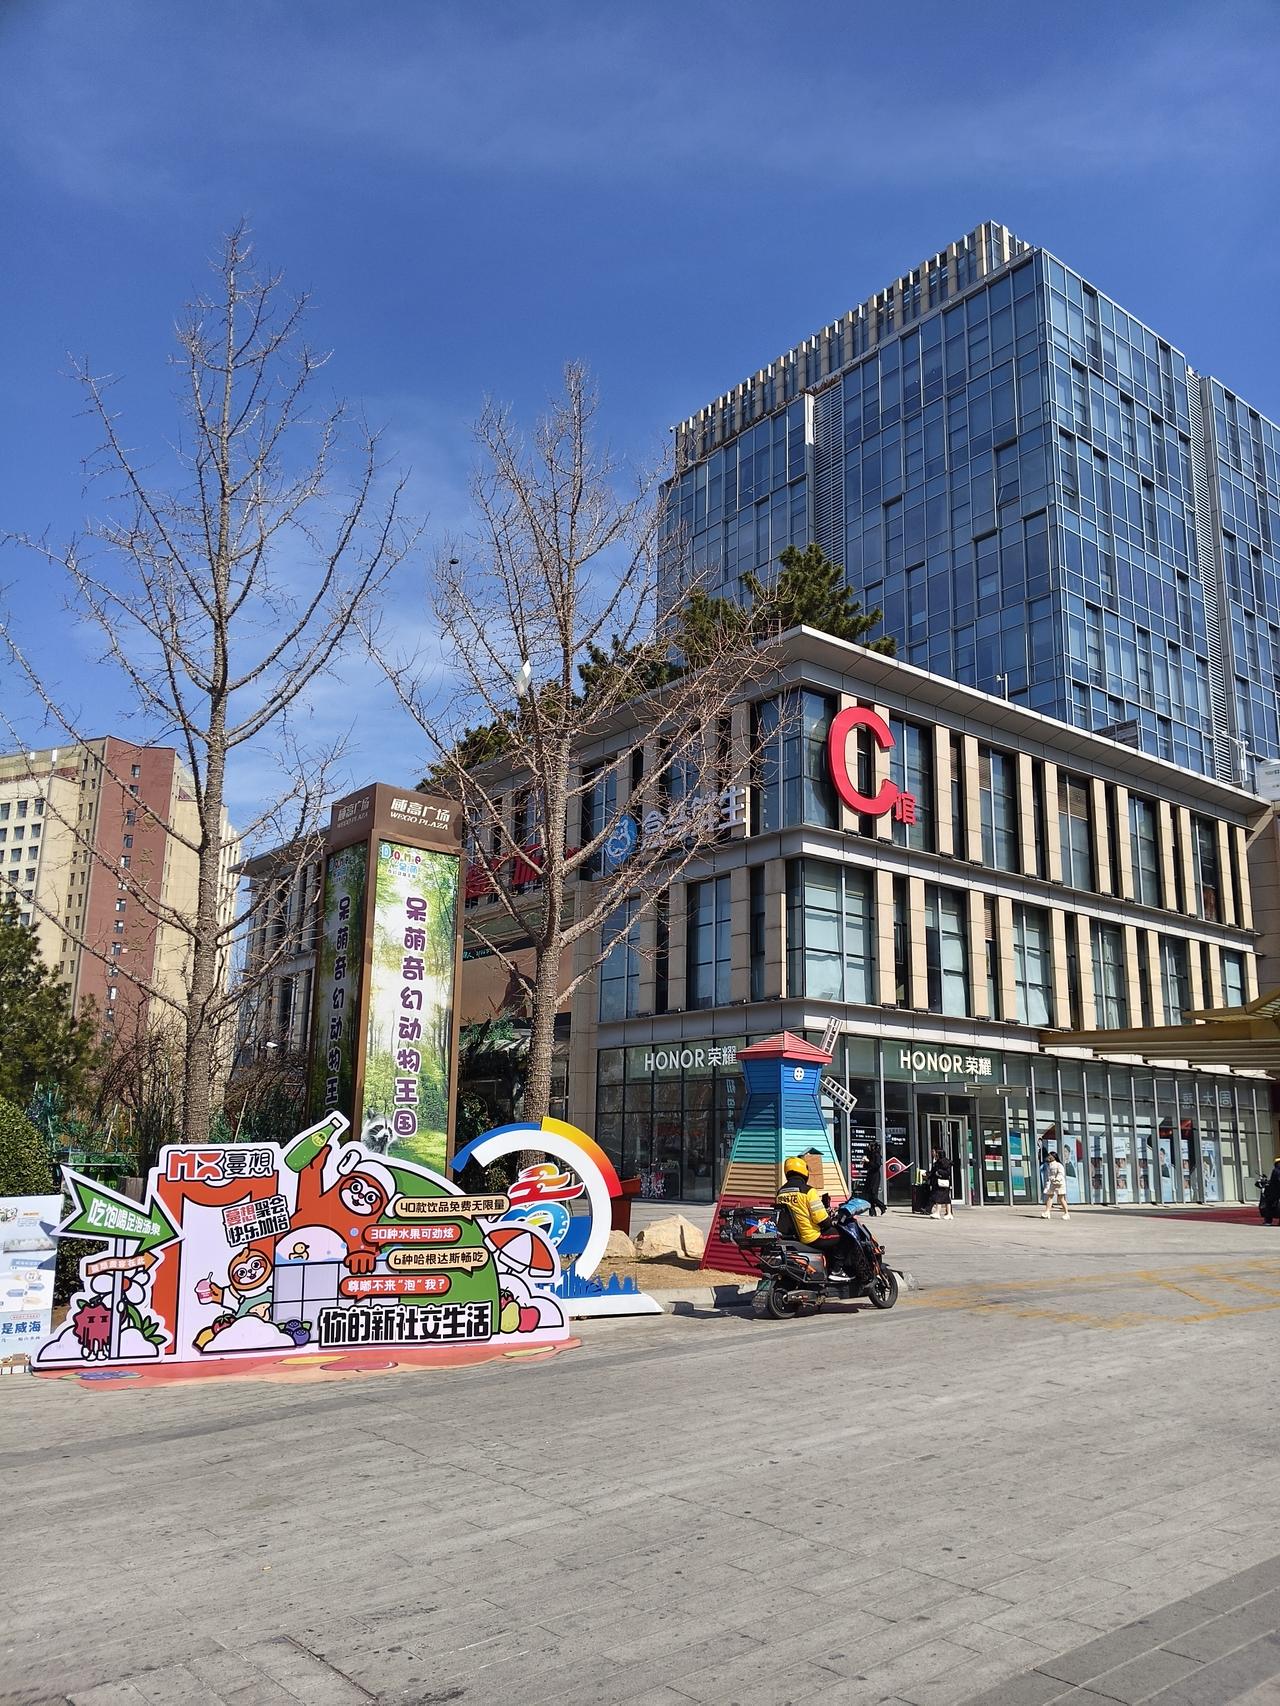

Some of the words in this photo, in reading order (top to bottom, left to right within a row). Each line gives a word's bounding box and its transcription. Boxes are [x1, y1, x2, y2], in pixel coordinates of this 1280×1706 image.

[390, 798, 450, 822] 威高广场
[390, 811, 418, 823] WEGO
[418, 818, 449, 831] PLAZA
[324, 895, 350, 1116] 呆萌奇幻动物王
[394, 896, 427, 1136] 呆萌奇幻动物王国
[644, 1048, 705, 1072] HONOR
[707, 1045, 738, 1067] 荣耀
[900, 1048, 963, 1074] HONOR
[965, 1055, 992, 1076] 荣耀
[87, 1197, 161, 1236] 吃饱喝足泡汤泉
[400, 1199, 505, 1214] 40款饮品免费无限量
[229, 1213, 289, 1244] 快乐加倍
[371, 1227, 454, 1240] 30种水果可劲炫
[393, 1251, 483, 1265] 6种哈根达斯畅吃
[1, 1321, 41, 1335] 是威海
[323, 1305, 490, 1344] 你的新社交生活
